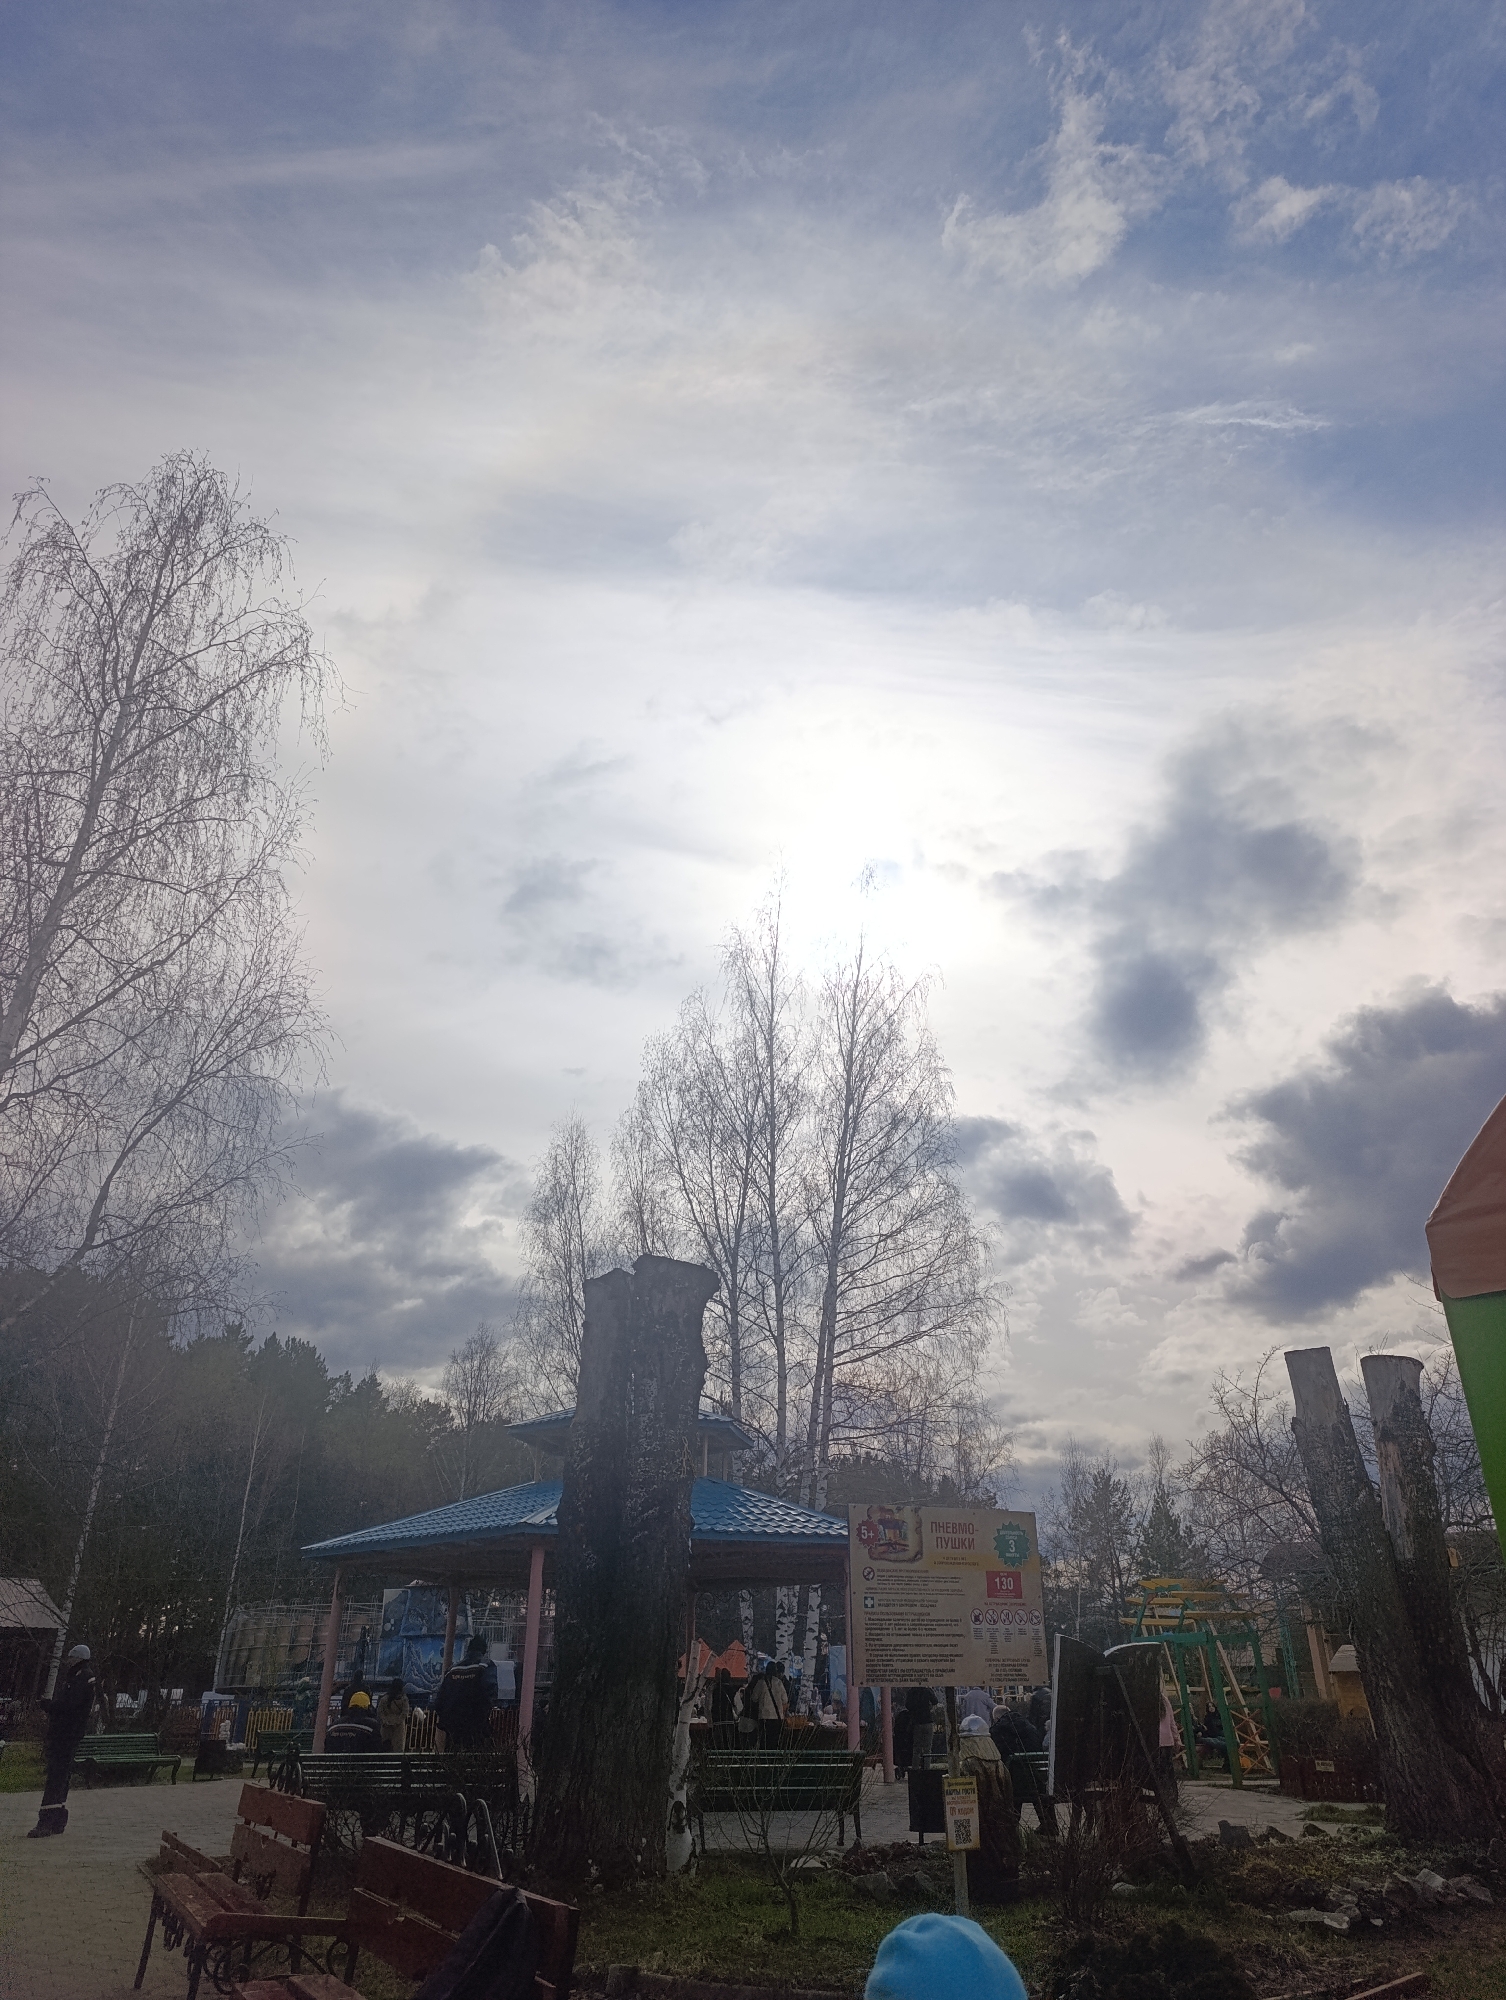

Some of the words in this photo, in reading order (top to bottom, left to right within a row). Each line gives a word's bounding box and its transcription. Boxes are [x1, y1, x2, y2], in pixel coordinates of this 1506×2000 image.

[861, 1525, 875, 1539] 5+
[930, 1521, 979, 1534] ПНЕВМО-
[936, 1537, 975, 1550] ПУШКИ
[1009, 1540, 1016, 1552] 3
[994, 1577, 1014, 1590] 130
